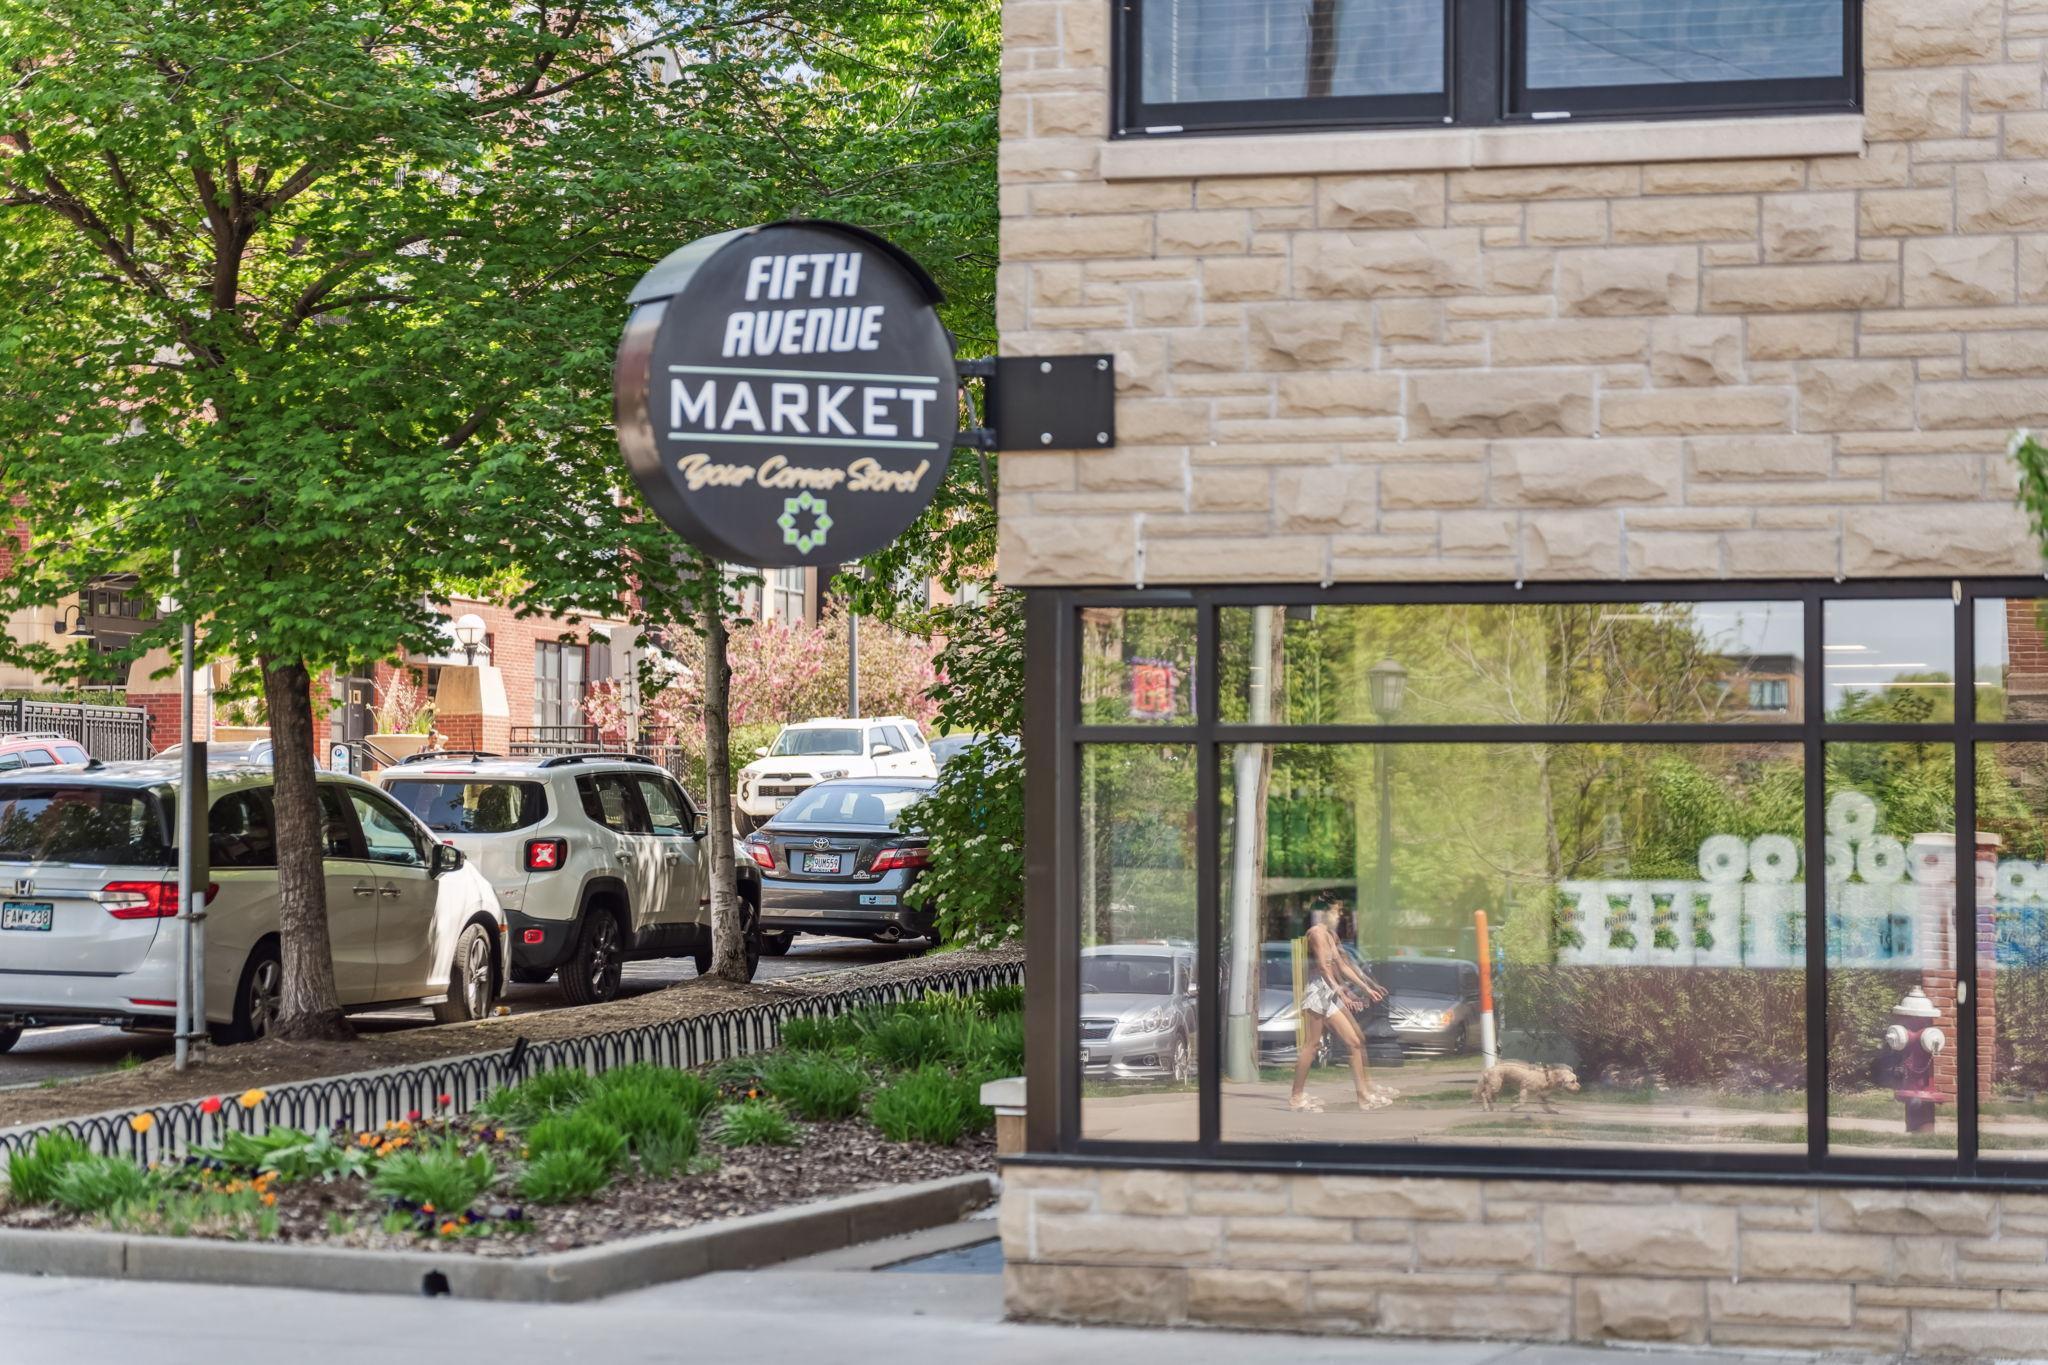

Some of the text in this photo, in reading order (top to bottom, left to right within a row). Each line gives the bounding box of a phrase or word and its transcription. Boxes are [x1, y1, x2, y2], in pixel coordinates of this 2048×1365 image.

[745, 252, 862, 301] FIFTH
[722, 305, 885, 357] AVENUE
[670, 378, 937, 438] MARKET
[677, 453, 930, 493] Your Corner Store!
